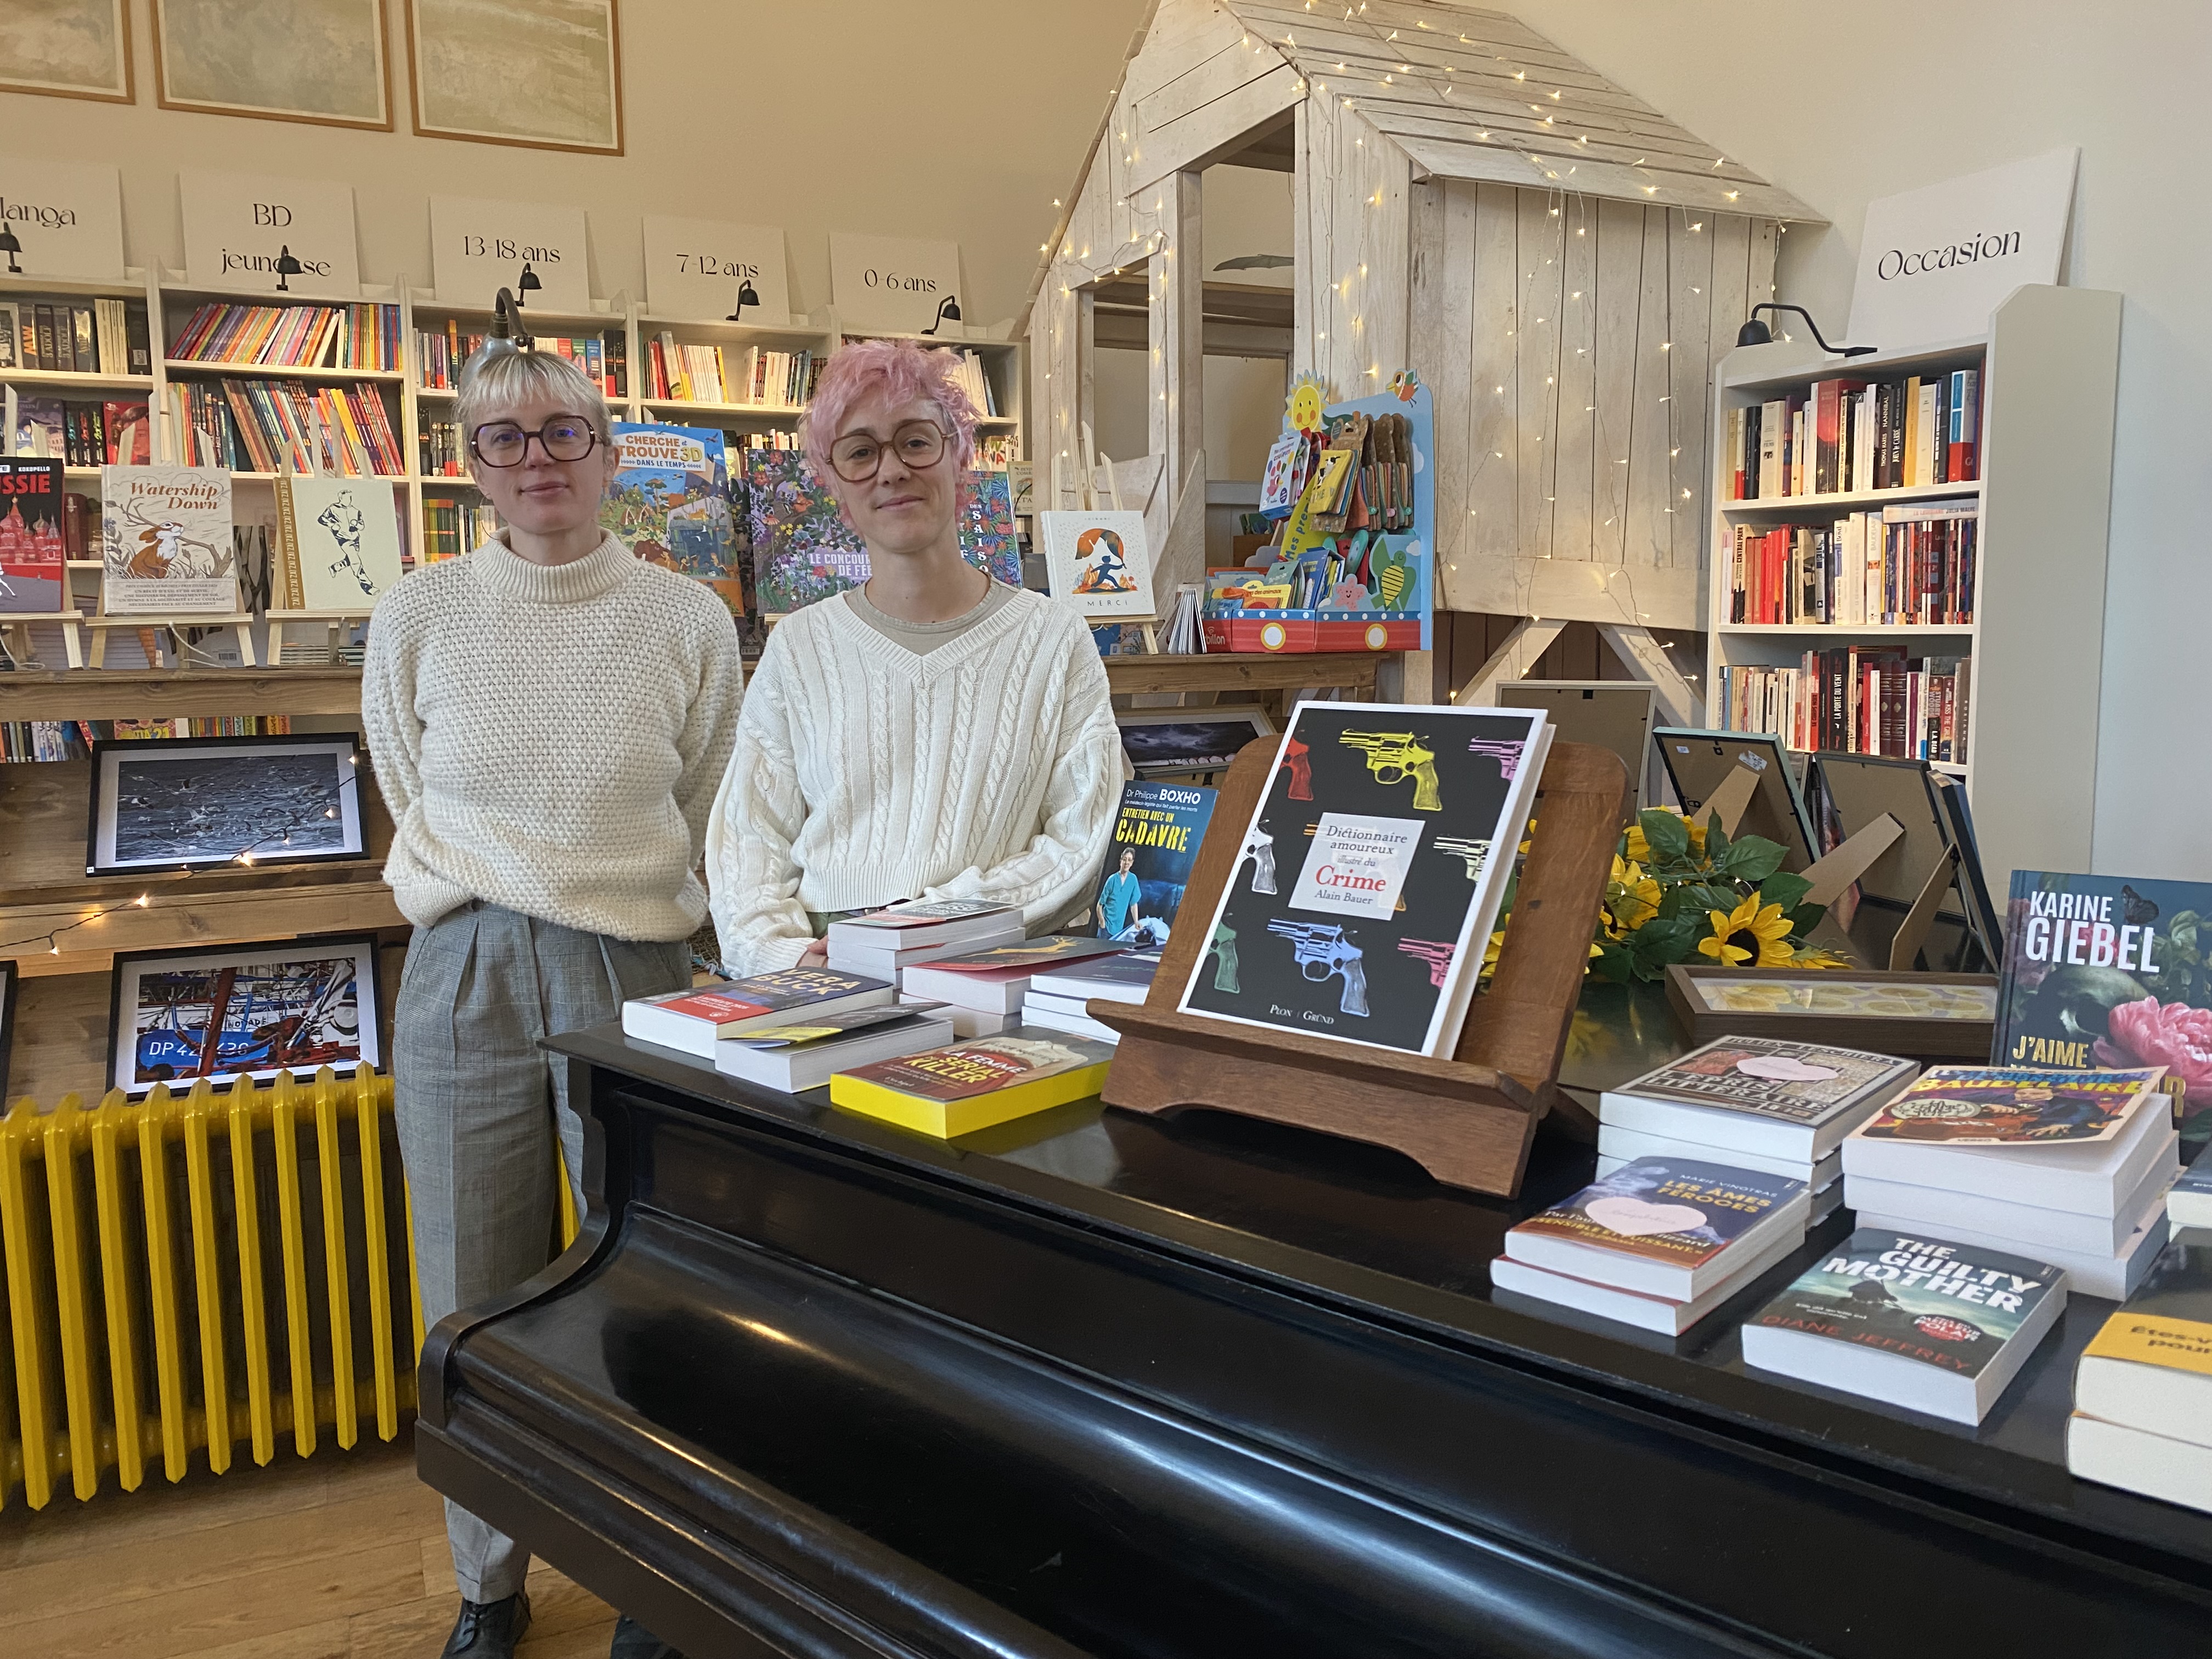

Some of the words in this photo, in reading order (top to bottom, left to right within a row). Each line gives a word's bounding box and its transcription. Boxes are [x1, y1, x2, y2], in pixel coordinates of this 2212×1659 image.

[252, 203, 292, 227] BD
[464, 235, 517, 259] 13-18
[522, 246, 561, 263] ans
[1878, 231, 2021, 280] Occasion
[221, 248, 331, 277] jeunse
[676, 253, 718, 275] 7-12
[723, 262, 759, 278] ans
[864, 269, 899, 290] 0-6
[904, 277, 936, 292] ans
[625, 435, 680, 447] CHERCHE
[618, 445, 679, 460] TROUVE
[680, 447, 703, 462] 3D
[0, 473, 50, 494] SSIE
[131, 482, 218, 500] Watership
[167, 496, 218, 510] Down
[810, 554, 821, 564] LE
[1284, 537, 1299, 560] Mes
[838, 565, 851, 576] DE
[1834, 674, 1842, 687] VENT
[1833, 711, 1841, 719] LA
[1126, 789, 1134, 797] Dr
[1134, 789, 1158, 800] Philippe
[1159, 788, 1201, 805] BOXHO
[1121, 807, 1150, 820] ENTRETIEN
[1149, 810, 1165, 822] AVEC
[1165, 812, 1175, 823] UN
[1115, 818, 1192, 853] CADAVRE
[1327, 825, 1408, 844] Dictionnaire
[1330, 840, 1395, 855] amoureux
[1337, 855, 1363, 866] illustré
[1364, 857, 1376, 867] du
[1315, 864, 1387, 892] Crime
[1314, 889, 1341, 901] Alain
[1342, 892, 1374, 905] Bauer
[2029, 890, 2114, 922] KARINE
[2025, 917, 2160, 974] GIEBEL
[749, 974, 844, 996] BUCK
[781, 969, 862, 990] VERA
[149, 1042, 174, 1056] DP
[2012, 1035, 2089, 1069] J'AIME
[903, 1058, 988, 1085] KILLER
[939, 1057, 1007, 1079] SERIAL
[943, 1049, 967, 1058] LA
[965, 1054, 1028, 1074] FEMME
[1911, 1078, 2143, 1094] BAUDELAIRE
[1664, 1180, 1703, 1193] LES
[1679, 1173, 1717, 1187] MARIE
[1719, 1181, 1779, 1198] VINGTRAS
[1894, 1238, 1957, 1260] THE
[1878, 1250, 2043, 1294] GUILTY
[1821, 1257, 2024, 1314] MOTHER
[1762, 1315, 1843, 1336] DIANE
[1852, 1333, 1971, 1370] JEFFREY
